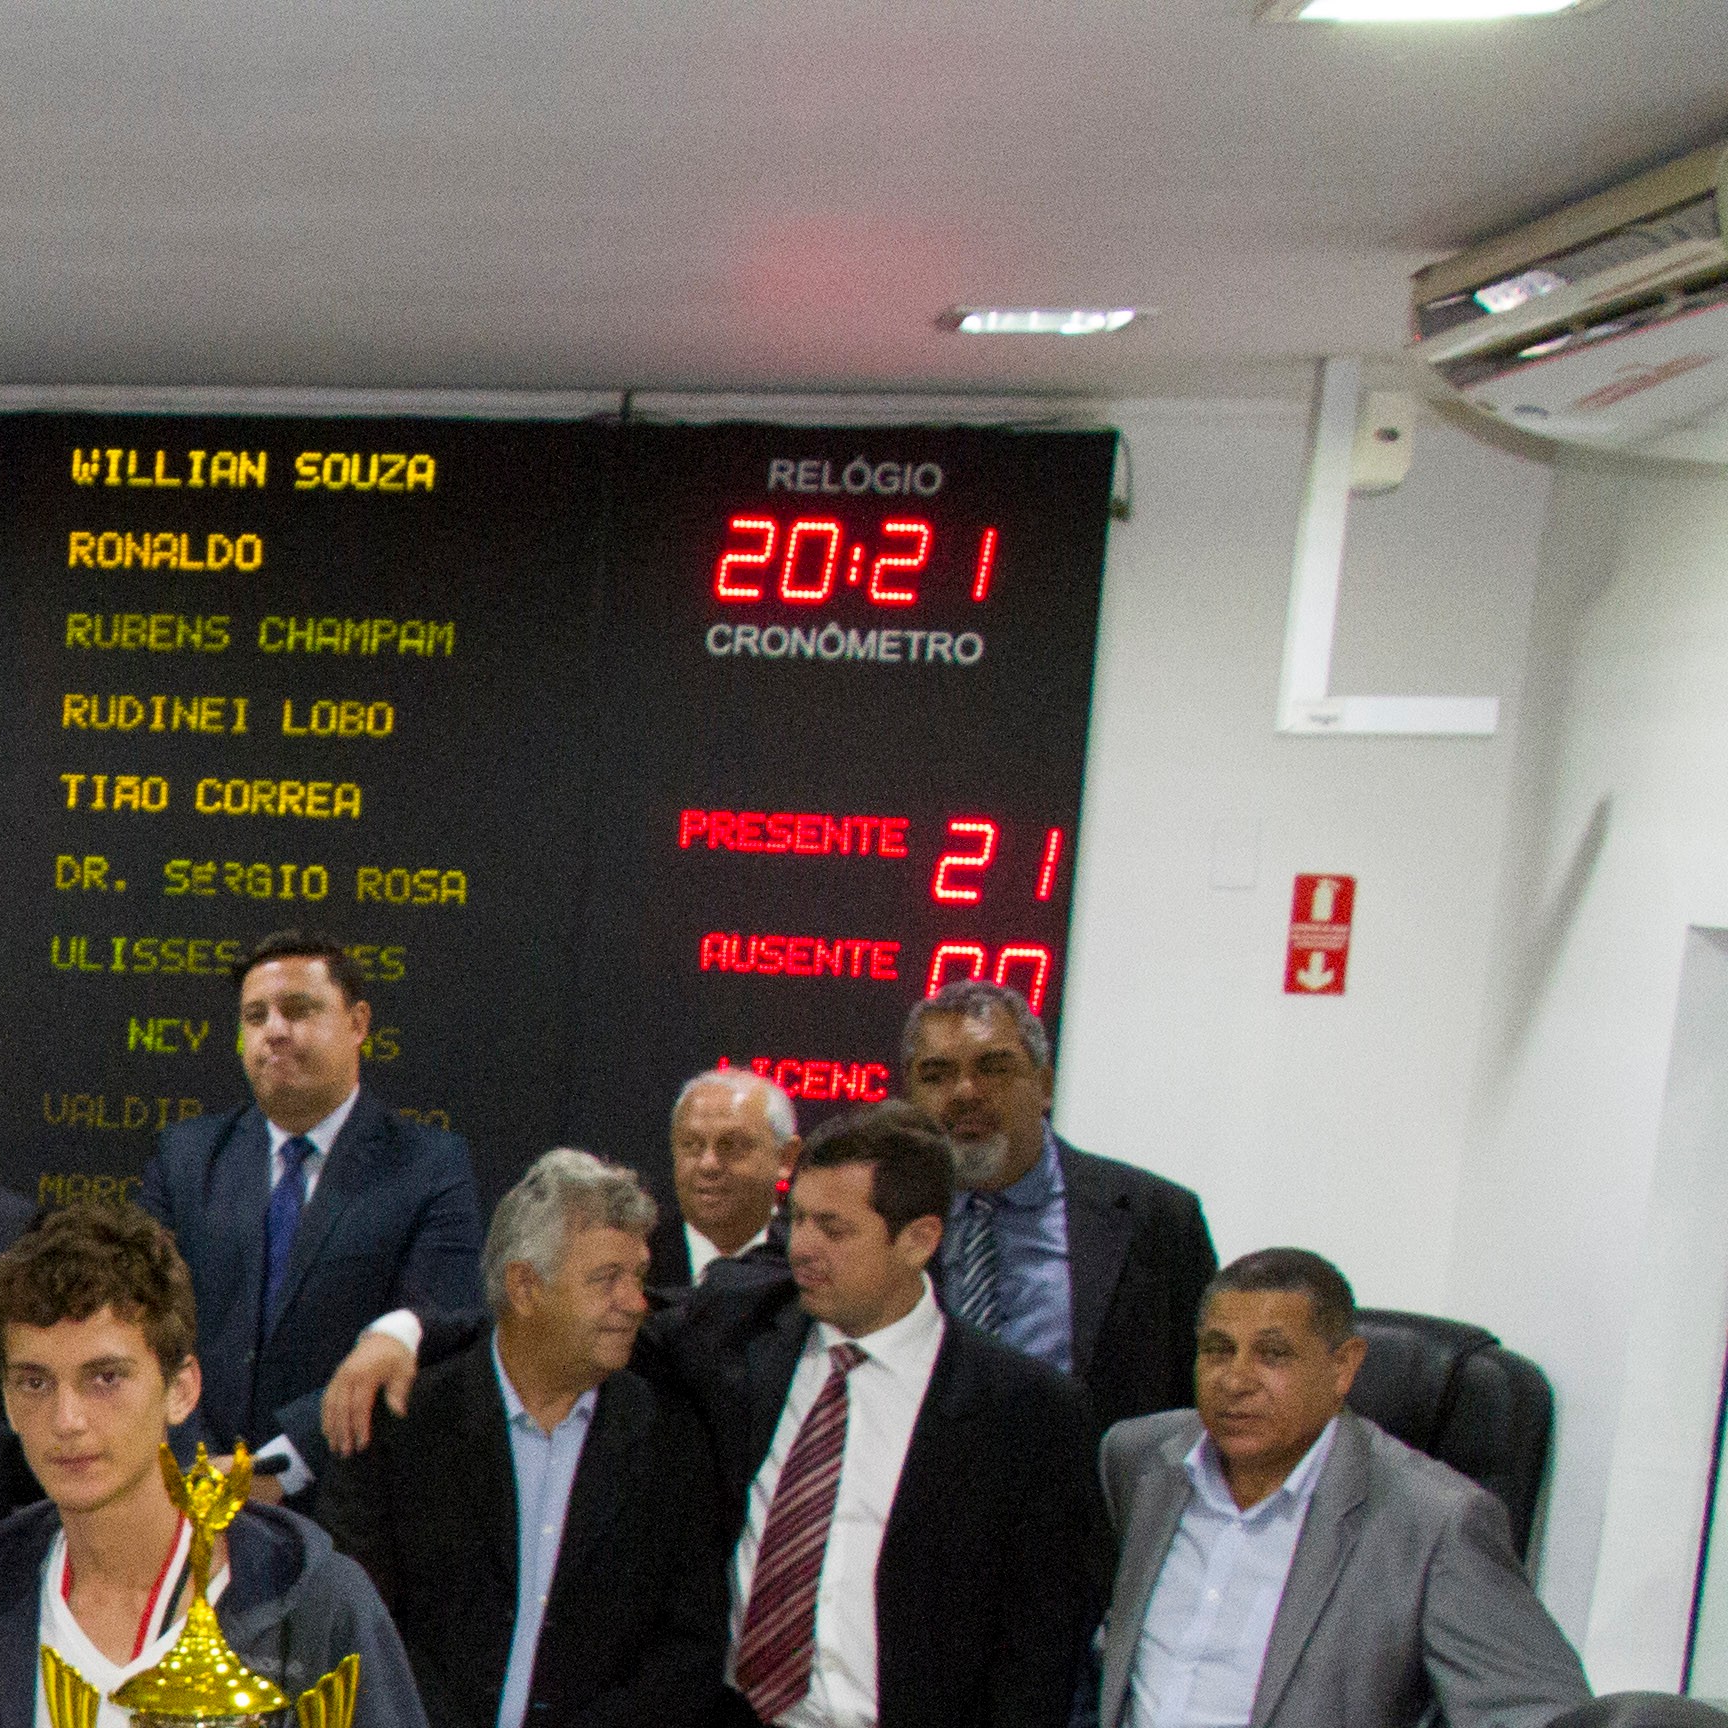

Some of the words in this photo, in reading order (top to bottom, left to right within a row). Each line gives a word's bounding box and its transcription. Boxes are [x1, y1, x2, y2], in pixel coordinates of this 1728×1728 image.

[72, 448, 267, 487] WILLIAN
[296, 451, 435, 492] SOUZA
[767, 456, 943, 495] RELÓGIO
[68, 531, 263, 571] RONALDO
[713, 515, 998, 604] 20:21
[65, 612, 231, 652] RUBENS
[258, 616, 454, 656] CHAMPAM
[706, 622, 984, 666] CRONÔMETRO
[61, 694, 249, 734] RUDINEI
[283, 699, 394, 737] LOBO
[195, 778, 362, 819] CORREA
[679, 809, 909, 858] PRESENTE
[931, 818, 1063, 903] 21
[55, 855, 127, 892] DR.
[356, 866, 467, 905] ROSA
[50, 935, 240, 975] ULISSES
[699, 931, 901, 980] AUSENTE
